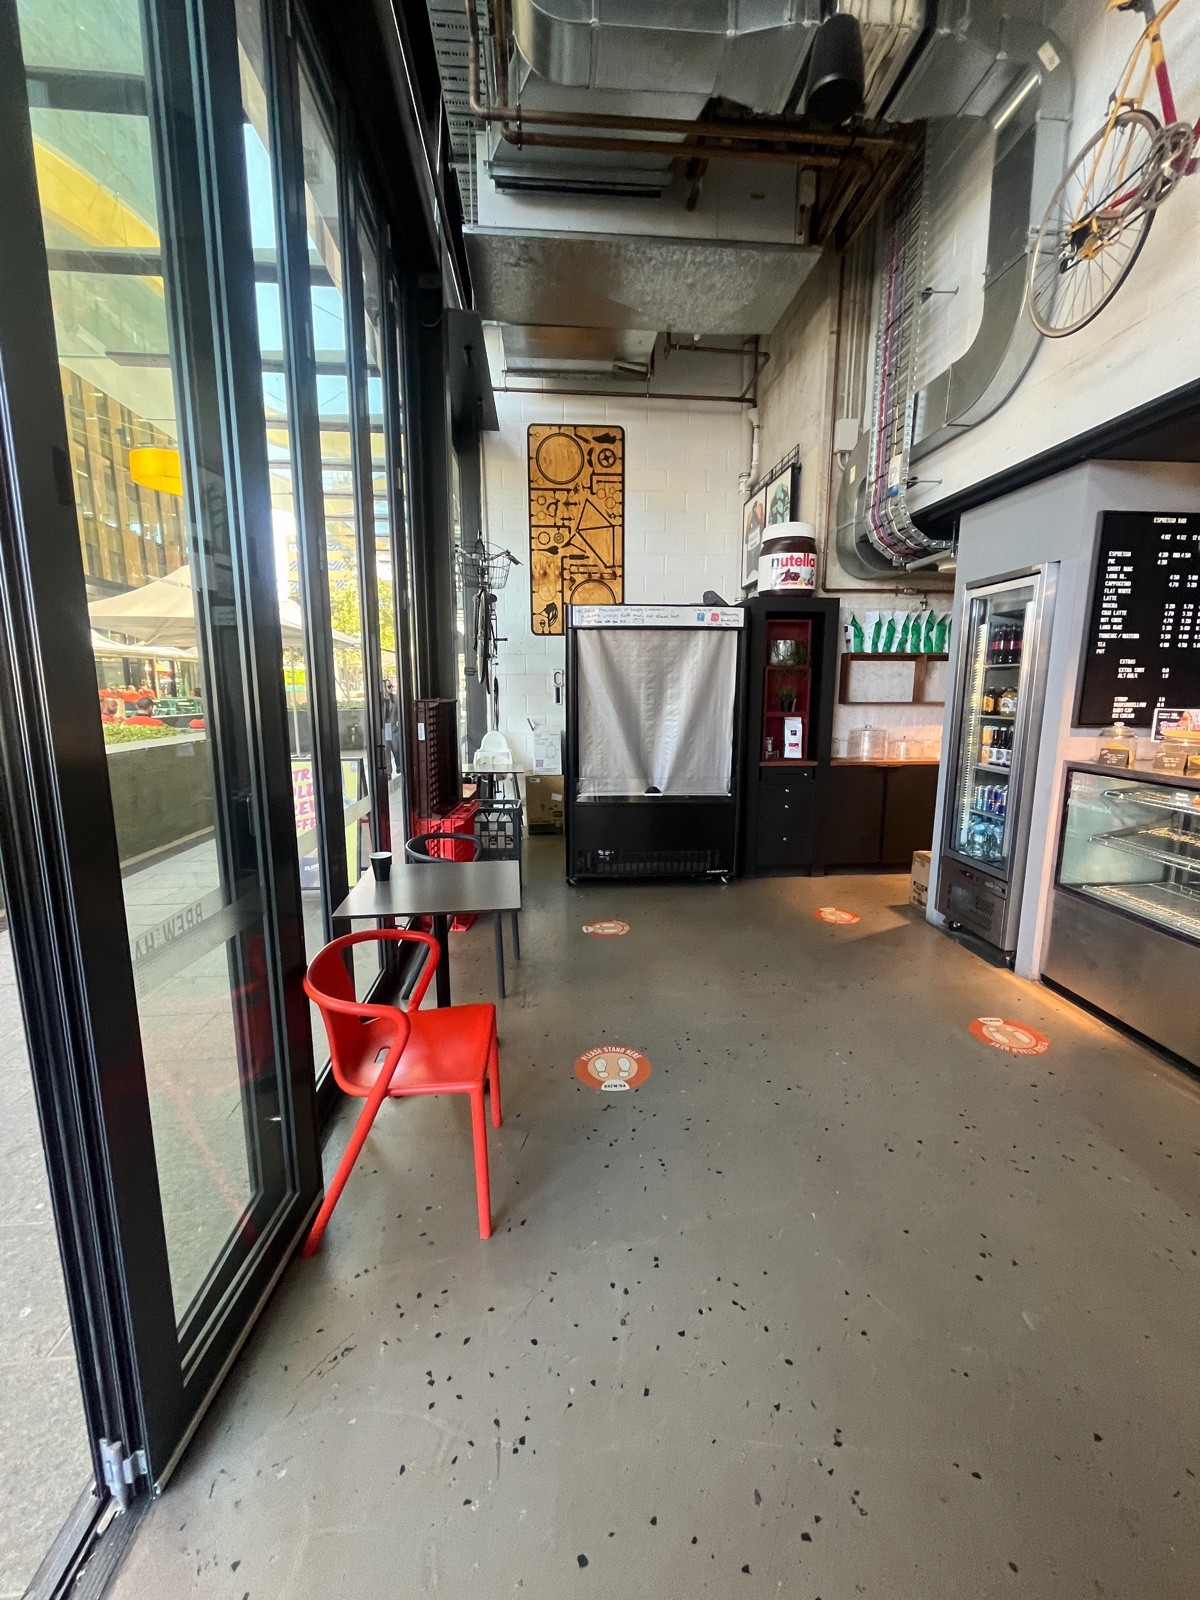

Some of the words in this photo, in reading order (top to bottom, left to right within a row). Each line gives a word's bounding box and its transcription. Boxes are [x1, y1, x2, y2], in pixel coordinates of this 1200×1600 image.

[771, 552, 815, 568] nutella
[580, 1048, 603, 1061] PLEASE
[625, 1049, 642, 1060] HERE
